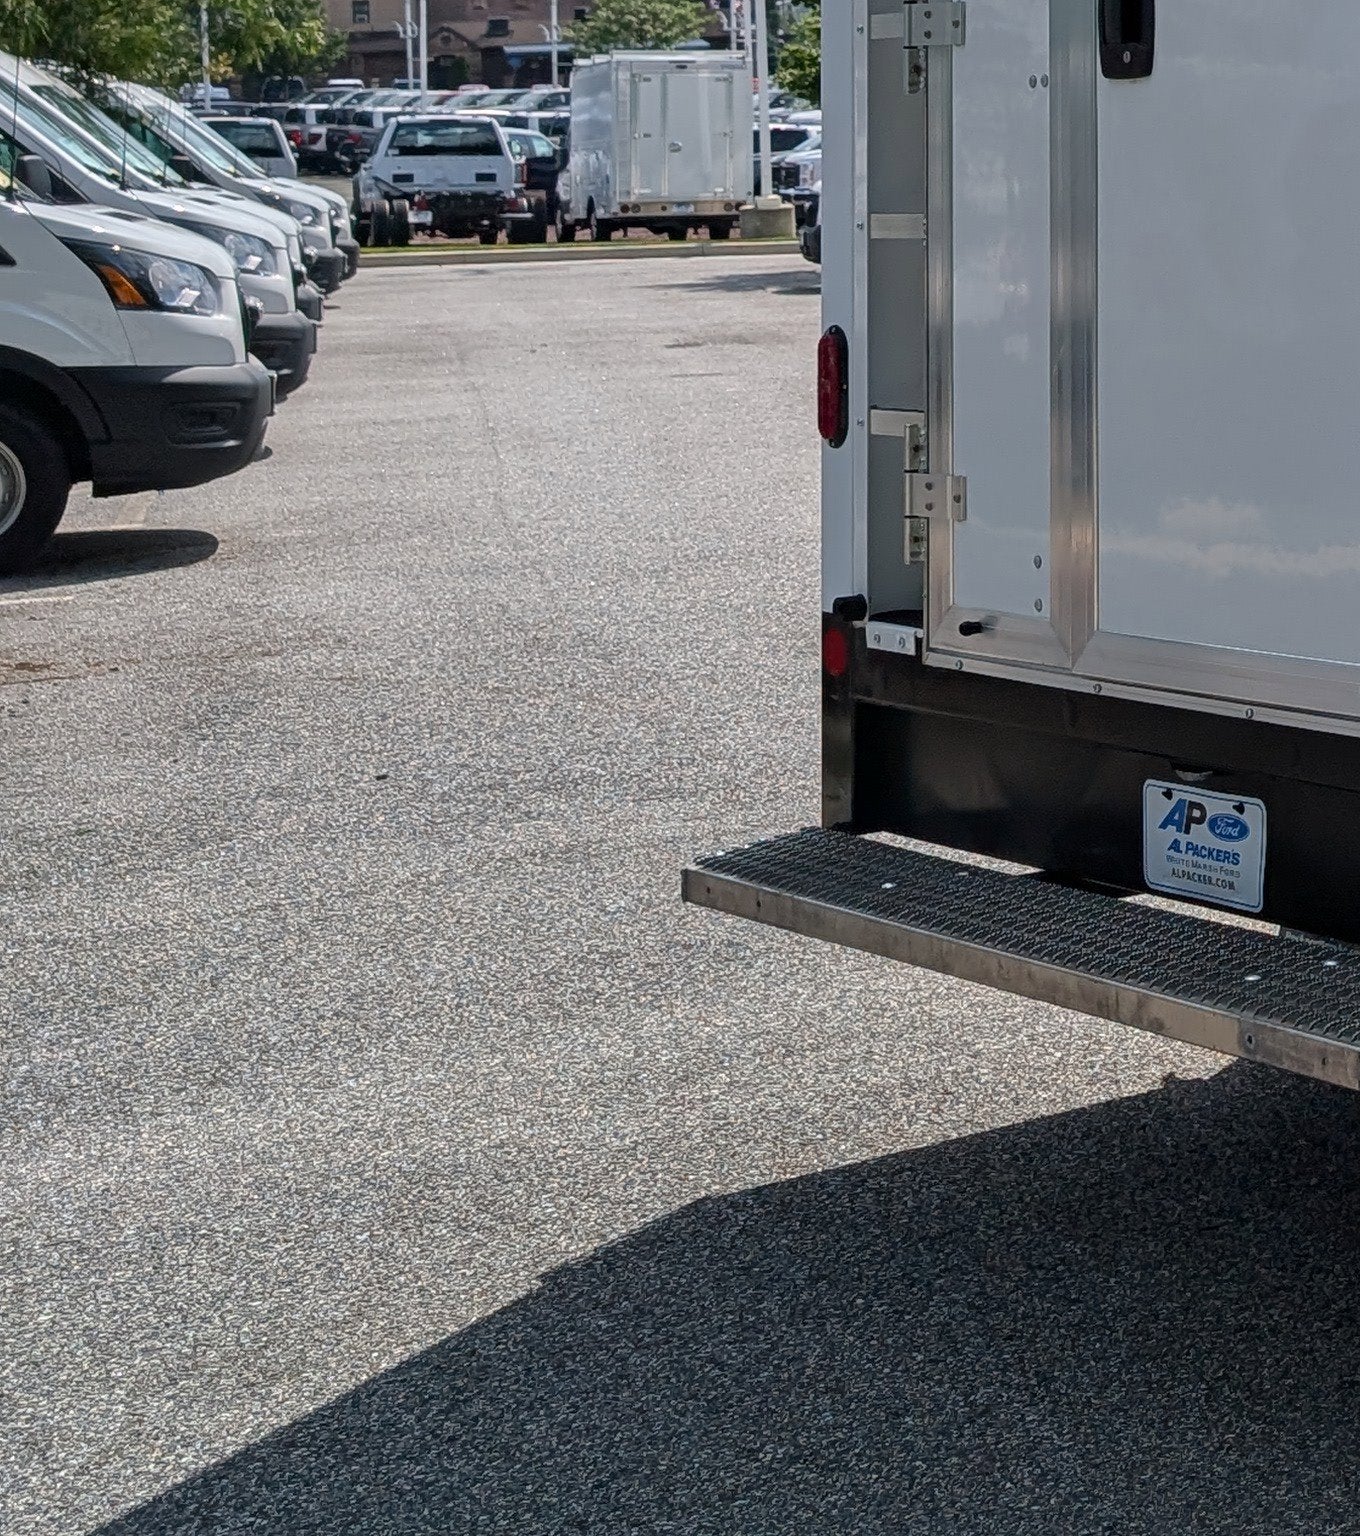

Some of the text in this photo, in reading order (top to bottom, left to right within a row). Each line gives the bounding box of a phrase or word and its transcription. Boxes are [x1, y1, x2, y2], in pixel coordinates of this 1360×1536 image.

[1158, 797, 1240, 837] AP Ford
[1167, 838, 1240, 865] AL PACKER'S
[1171, 867, 1236, 891] ALPACKER.COM
